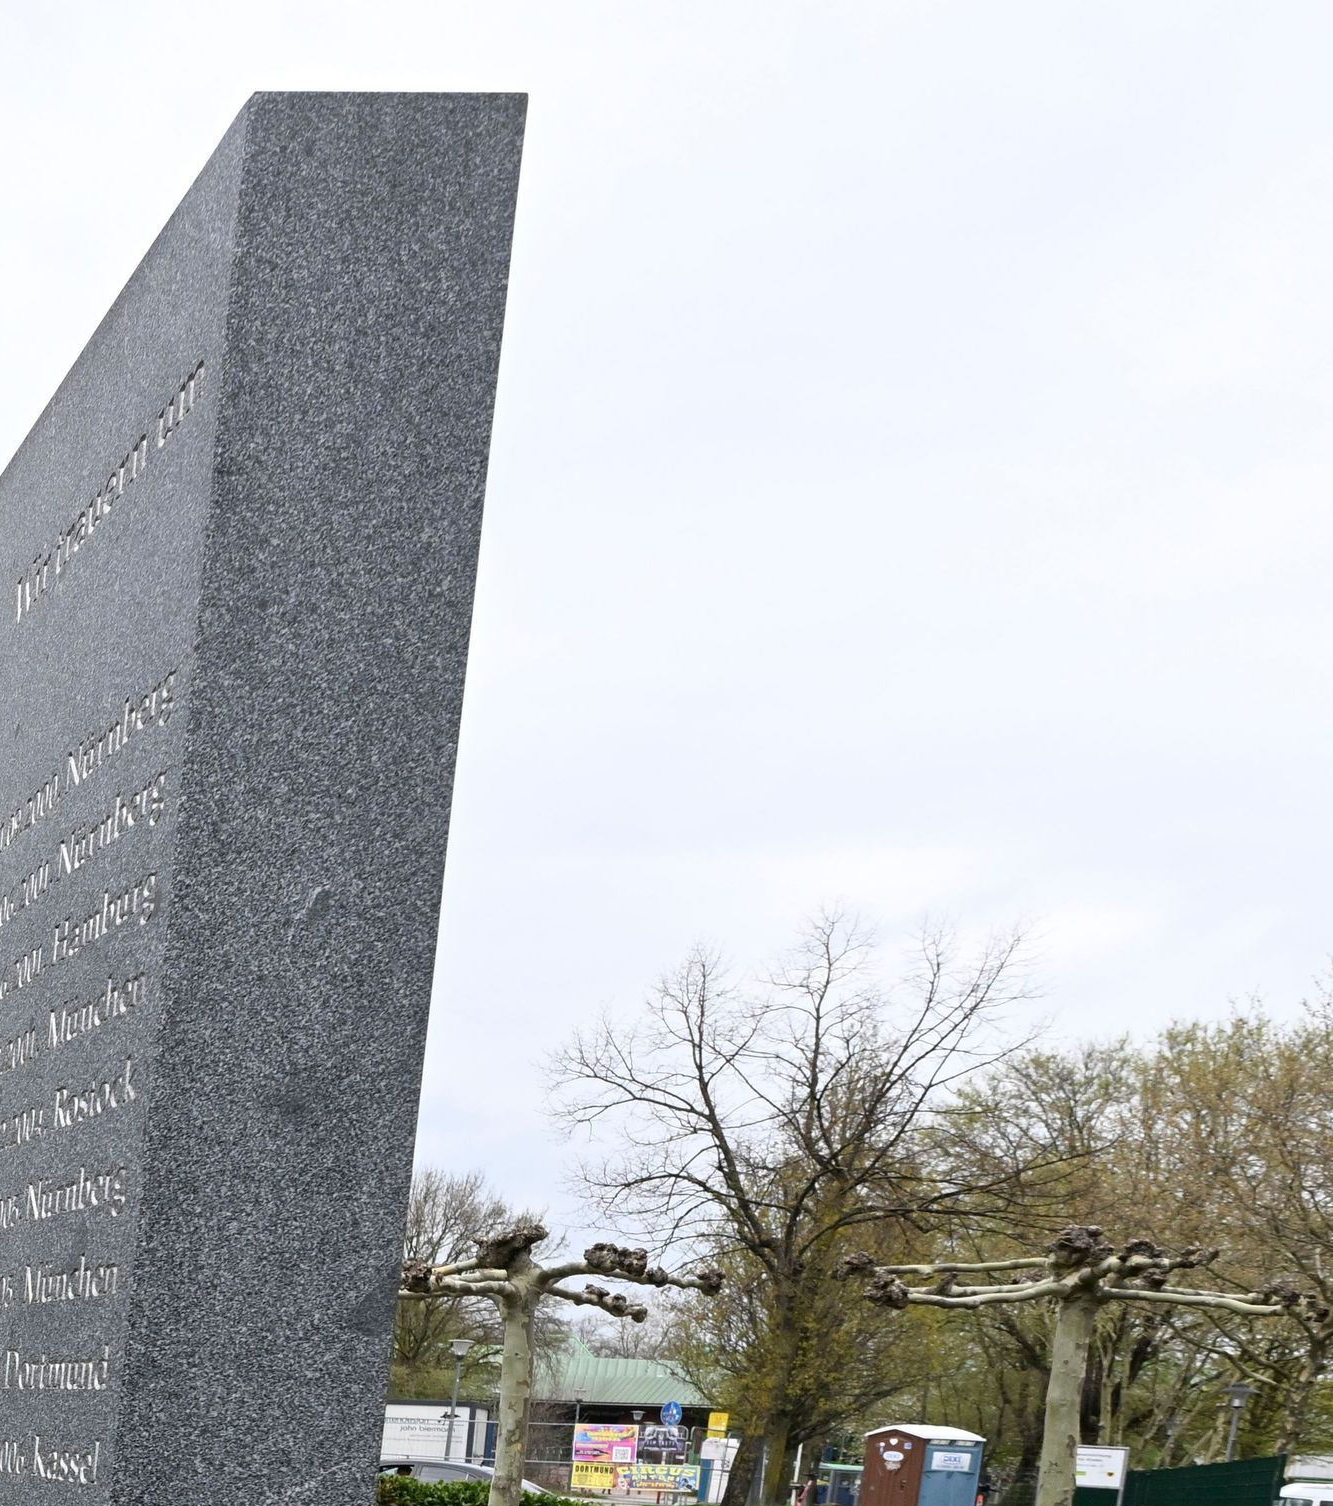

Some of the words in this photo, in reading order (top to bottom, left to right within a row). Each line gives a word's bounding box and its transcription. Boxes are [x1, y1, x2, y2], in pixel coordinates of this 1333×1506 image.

[16, 547, 50, 622] Wir
[55, 431, 149, 574] trauern
[158, 359, 206, 449] um
[67, 667, 177, 787] Nürnberg
[59, 772, 167, 876] Nürnberg
[52, 872, 157, 963] Hamburg
[47, 972, 148, 1049] München
[54, 1055, 136, 1128] Rostock
[25, 1163, 127, 1220] Nürnberg
[24, 1251, 119, 1304] München
[2, 1344, 109, 1390] Dortmund
[30, 1435, 100, 1485] Kassel
[575, 1465, 614, 1474] DORTMUND
[616, 1466, 695, 1477] CIRCUS
